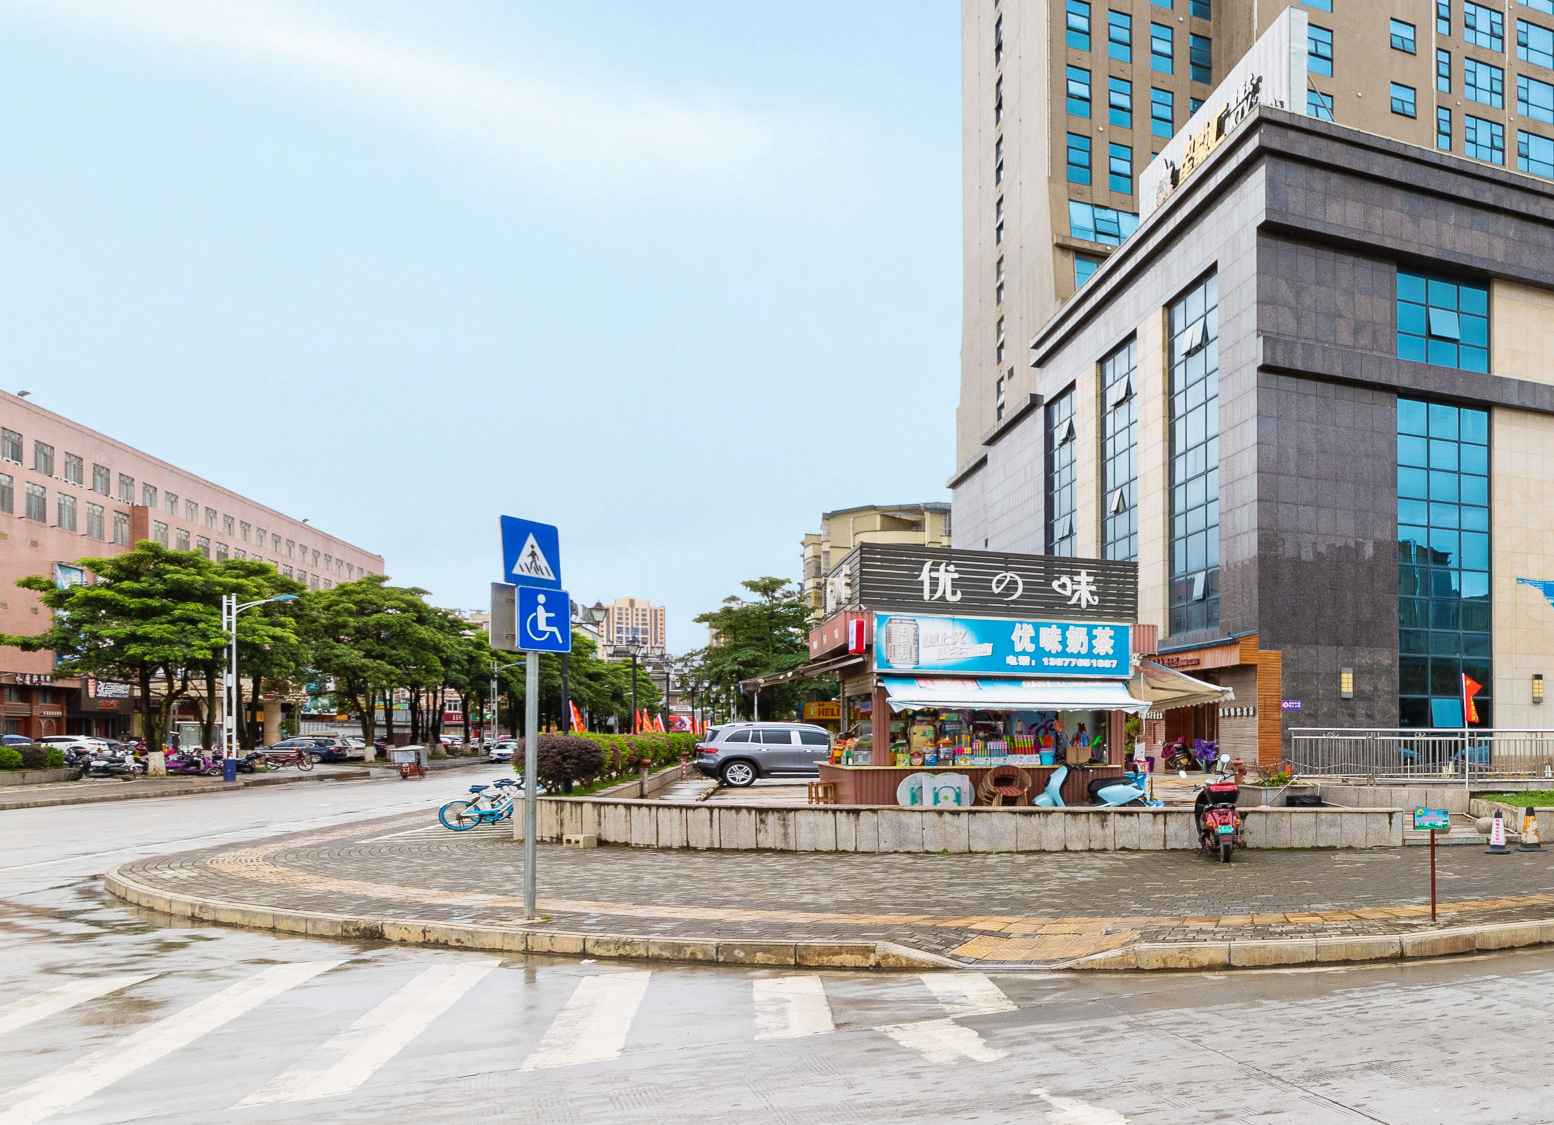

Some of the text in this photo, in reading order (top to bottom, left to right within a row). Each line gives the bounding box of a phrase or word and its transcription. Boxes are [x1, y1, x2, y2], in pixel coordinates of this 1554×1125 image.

[917, 561, 1100, 609] 优の味
[1011, 623, 1116, 655] 优味奶茶
